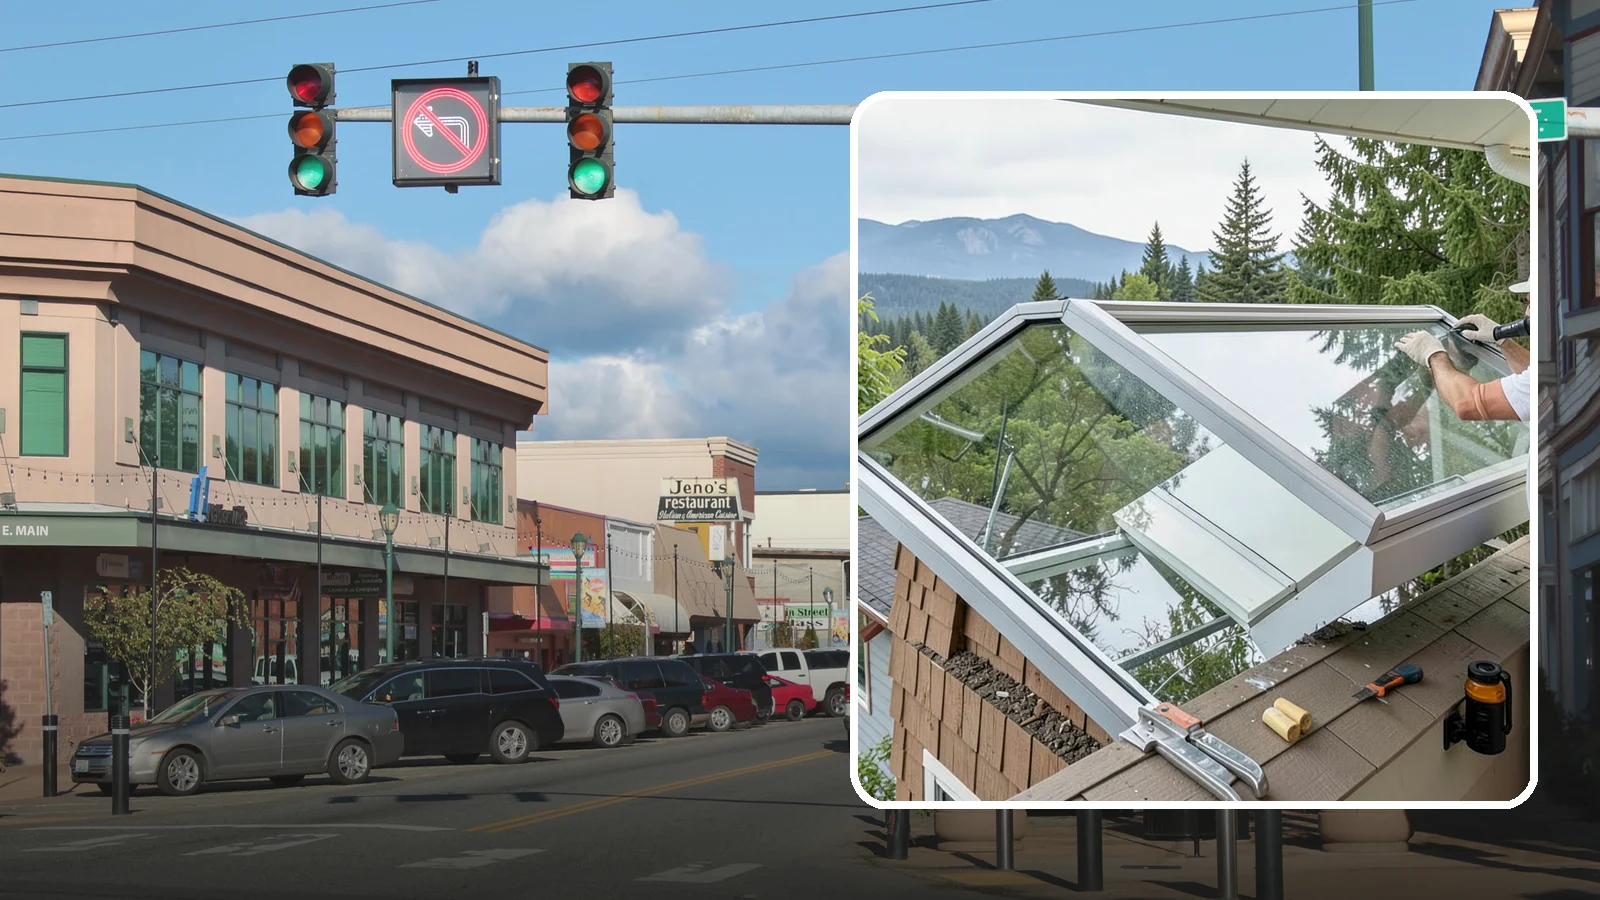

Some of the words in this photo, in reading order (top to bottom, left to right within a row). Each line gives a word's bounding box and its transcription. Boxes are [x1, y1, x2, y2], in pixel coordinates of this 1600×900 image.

[669, 479, 728, 495] Jeno's
[665, 496, 731, 509] restaurant
[2, 525, 13, 536] E.
[15, 525, 49, 536] MAIN
[797, 607, 828, 617] Street
[790, 619, 824, 627] lass
